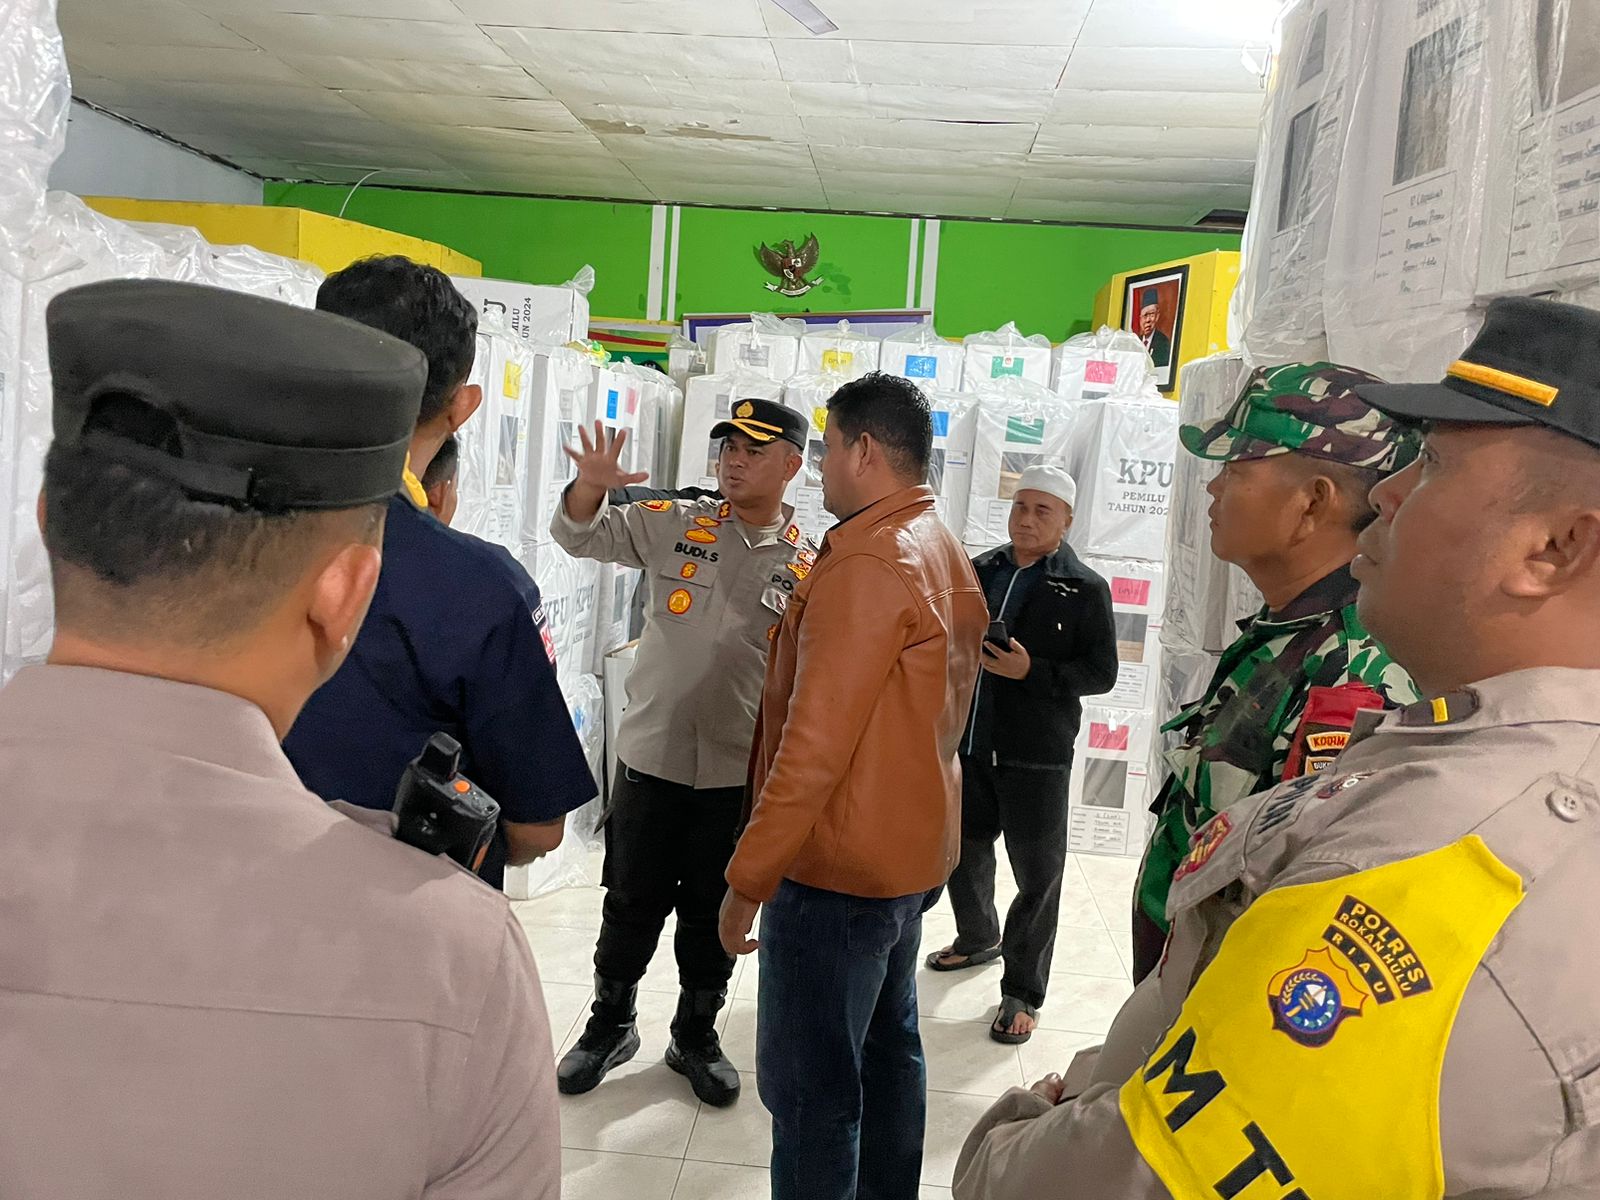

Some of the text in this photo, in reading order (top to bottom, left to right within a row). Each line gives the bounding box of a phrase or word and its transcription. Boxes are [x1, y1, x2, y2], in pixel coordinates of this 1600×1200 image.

[523, 297, 532, 322] 2024
[1116, 458, 1175, 488] KPU
[1107, 502, 1169, 516] TAHUN 202
[1122, 491, 1166, 503] PEMILU
[1313, 735, 1346, 747] KODIM
[1340, 912, 1412, 991] ROKAN HULU
[1350, 903, 1425, 983] POLRES
[1331, 932, 1387, 993] RIAU
[1212, 1120, 1312, 1200] T
